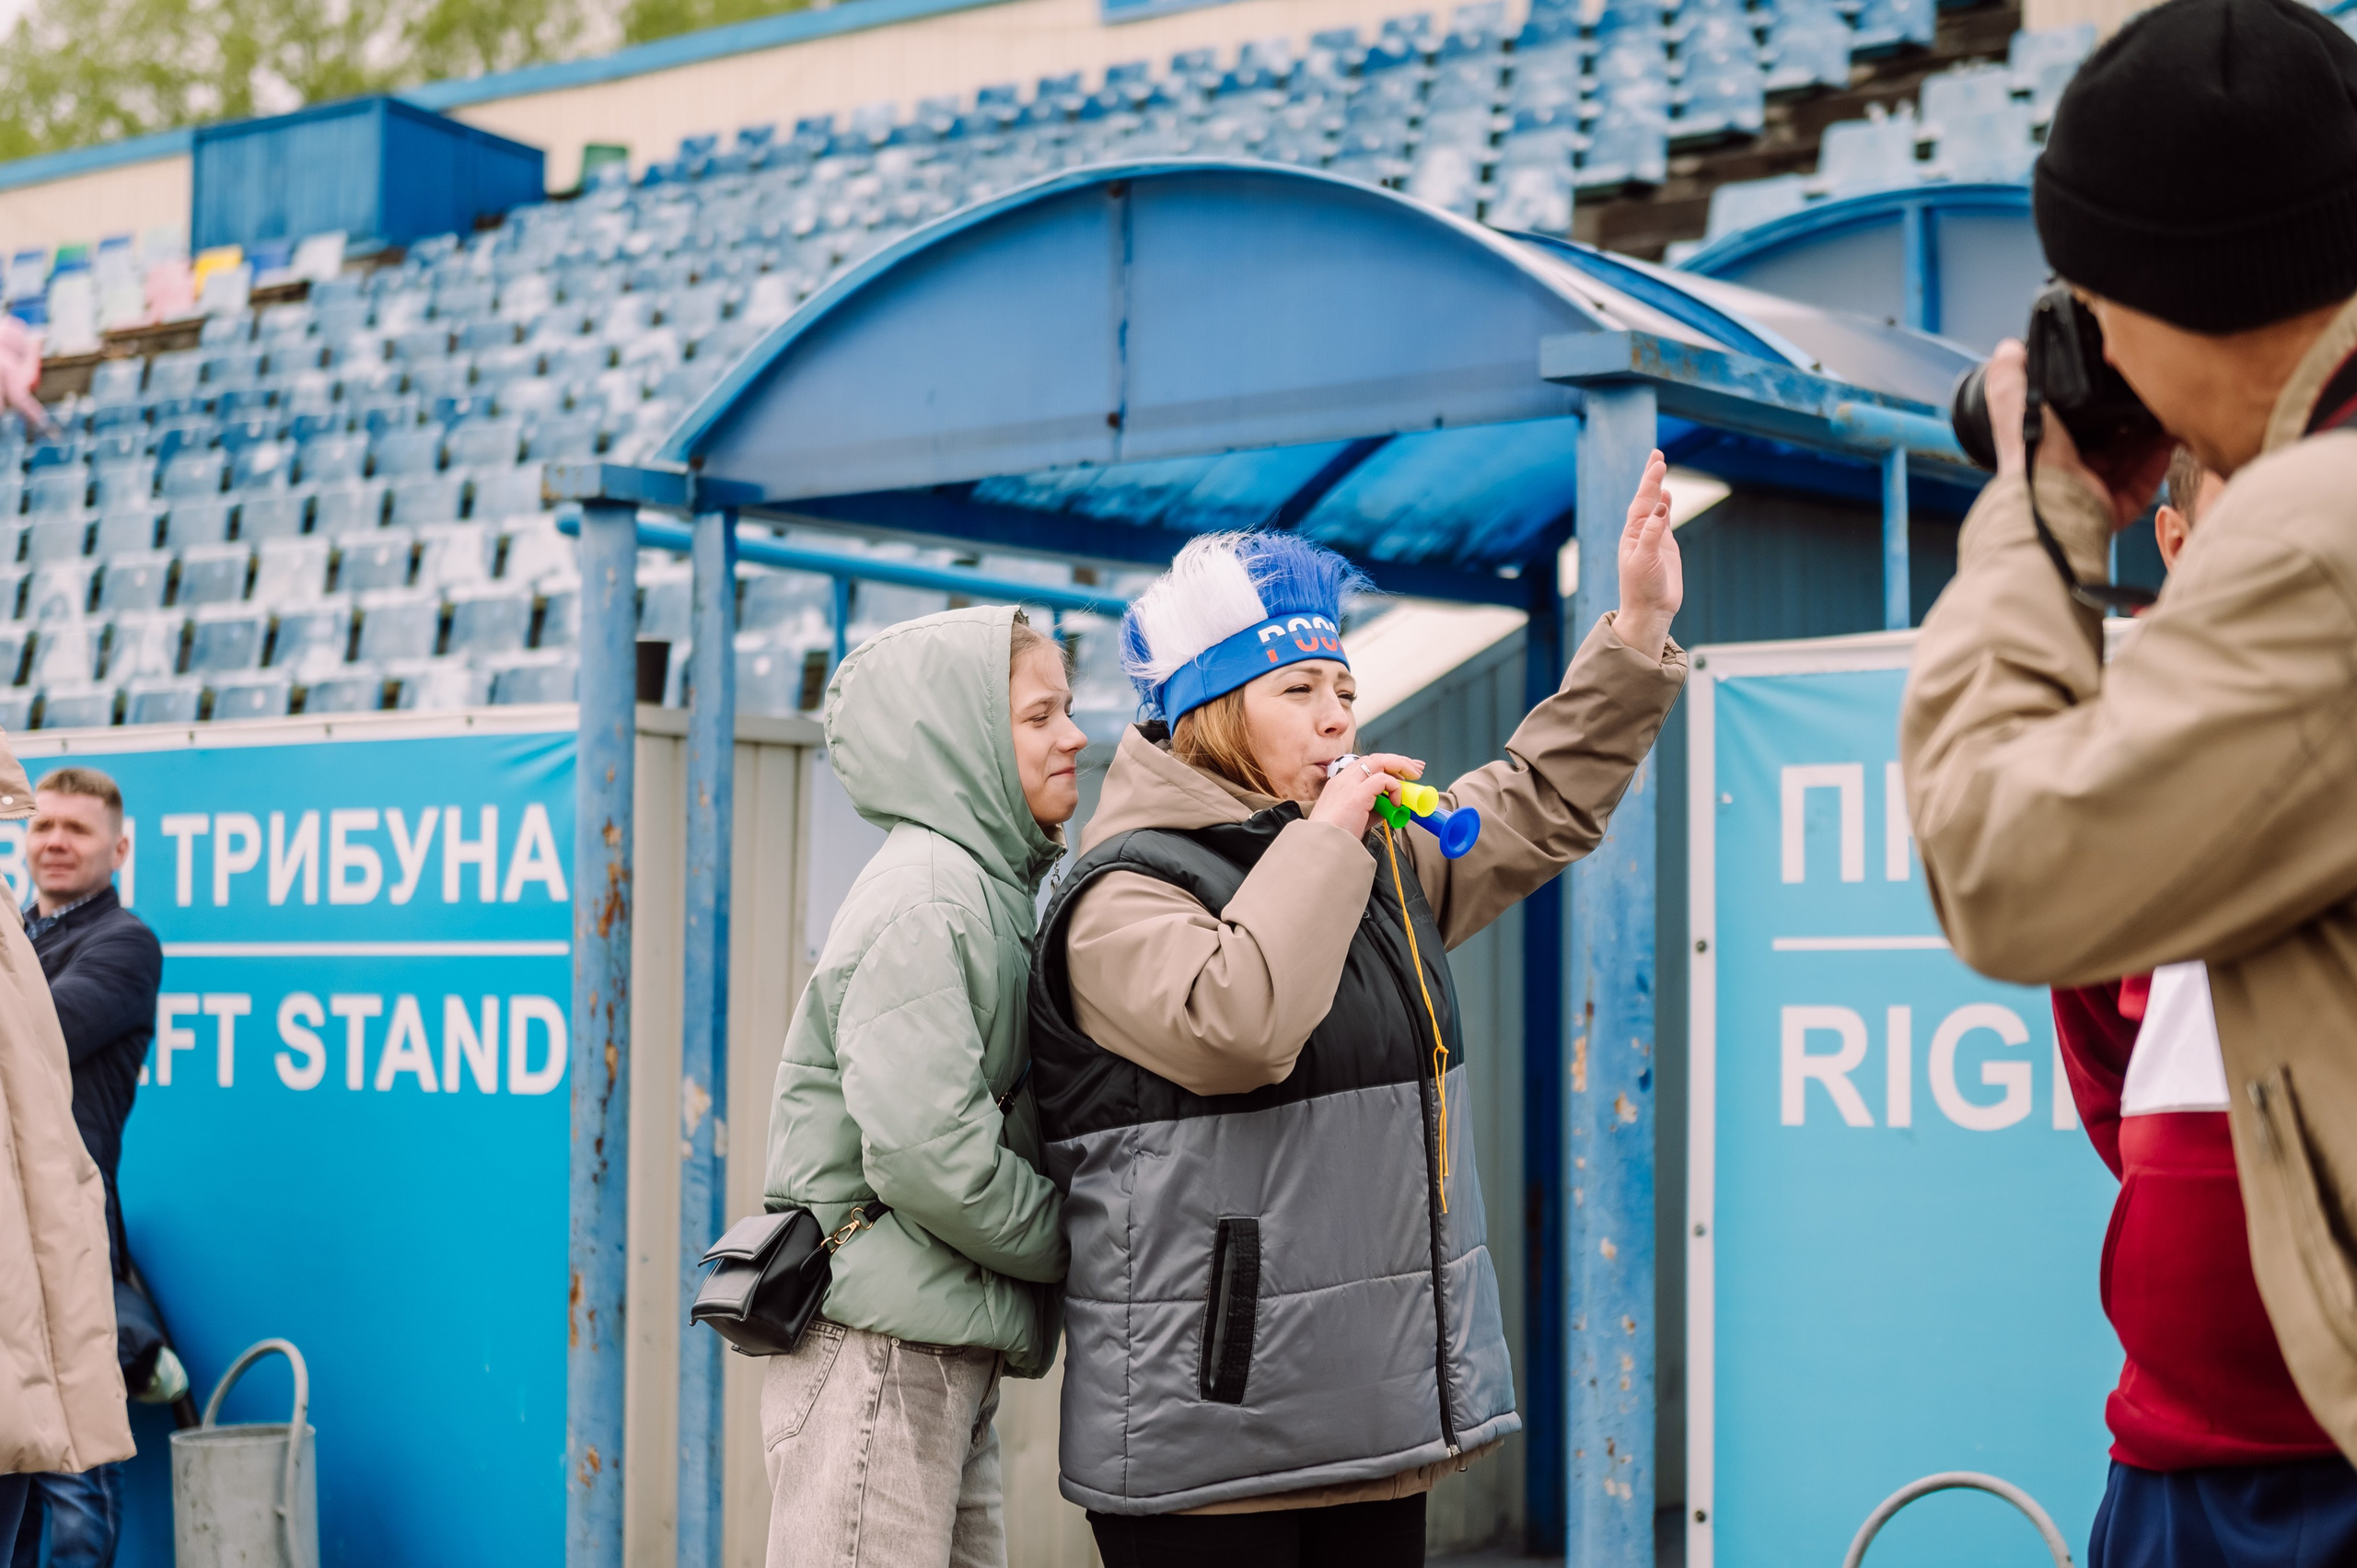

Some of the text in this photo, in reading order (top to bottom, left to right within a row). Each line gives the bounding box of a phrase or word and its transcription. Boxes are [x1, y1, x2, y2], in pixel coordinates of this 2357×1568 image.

[161, 803, 569, 907] ТРИБУНА
[138, 992, 569, 1095] FT STAND
